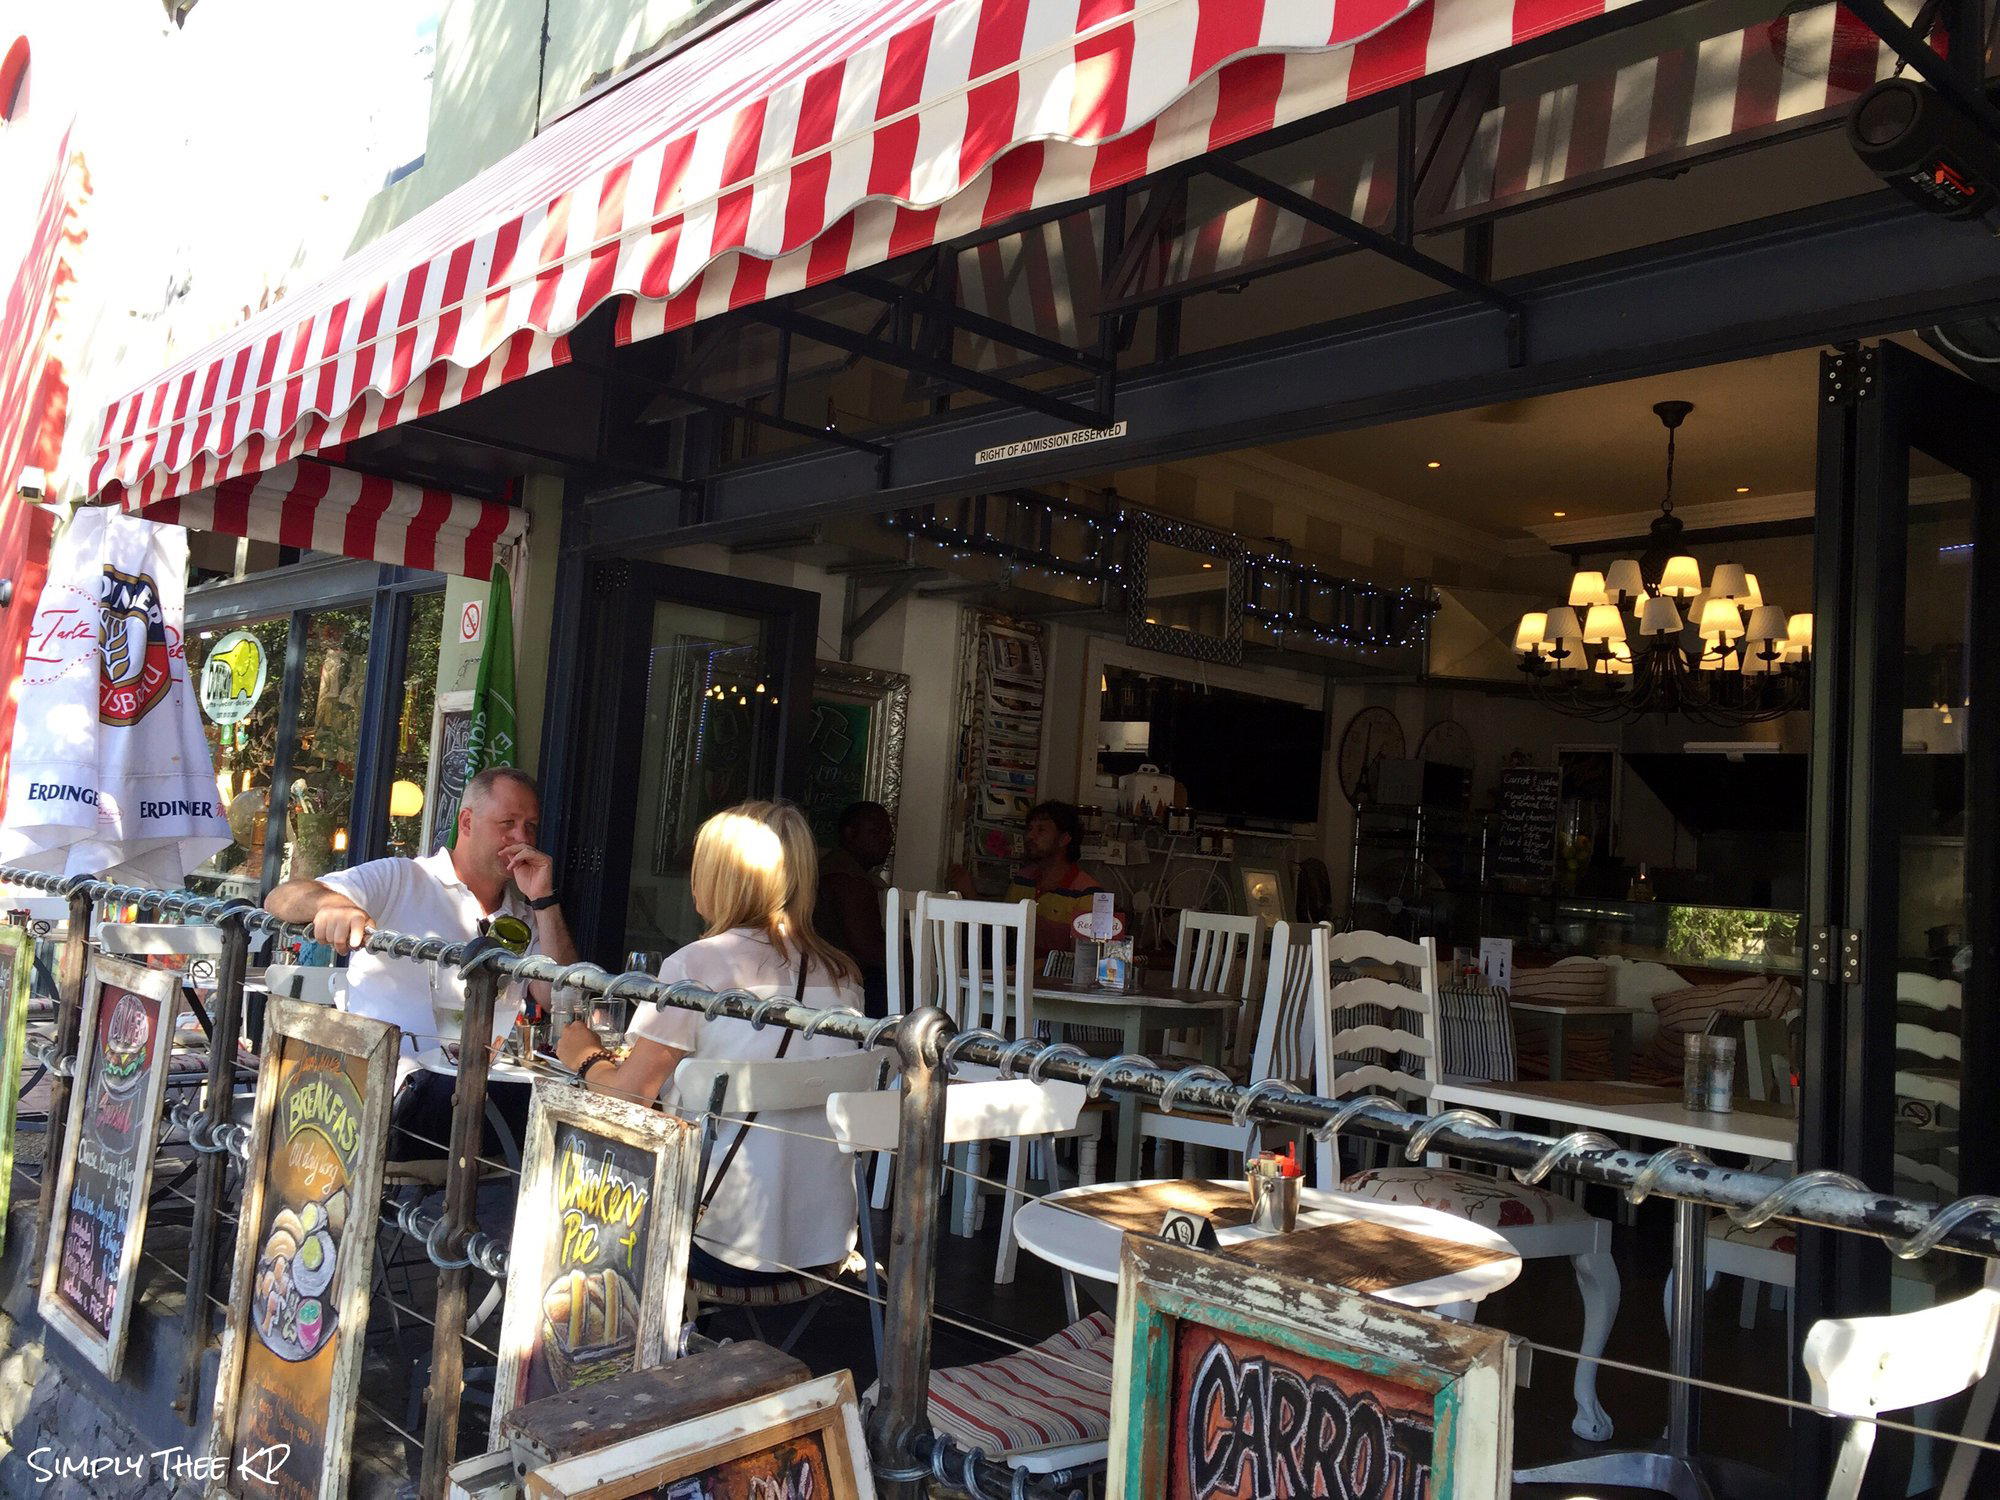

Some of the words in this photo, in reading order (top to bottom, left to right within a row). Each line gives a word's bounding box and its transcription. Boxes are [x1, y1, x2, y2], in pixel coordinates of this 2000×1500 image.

[980, 447, 1005, 463] RIGHT
[1007, 444, 1019, 457] OF
[1020, 434, 1070, 454] ADMISSION
[1071, 424, 1122, 444] RESERVED
[561, 1208, 600, 1267] Pie
